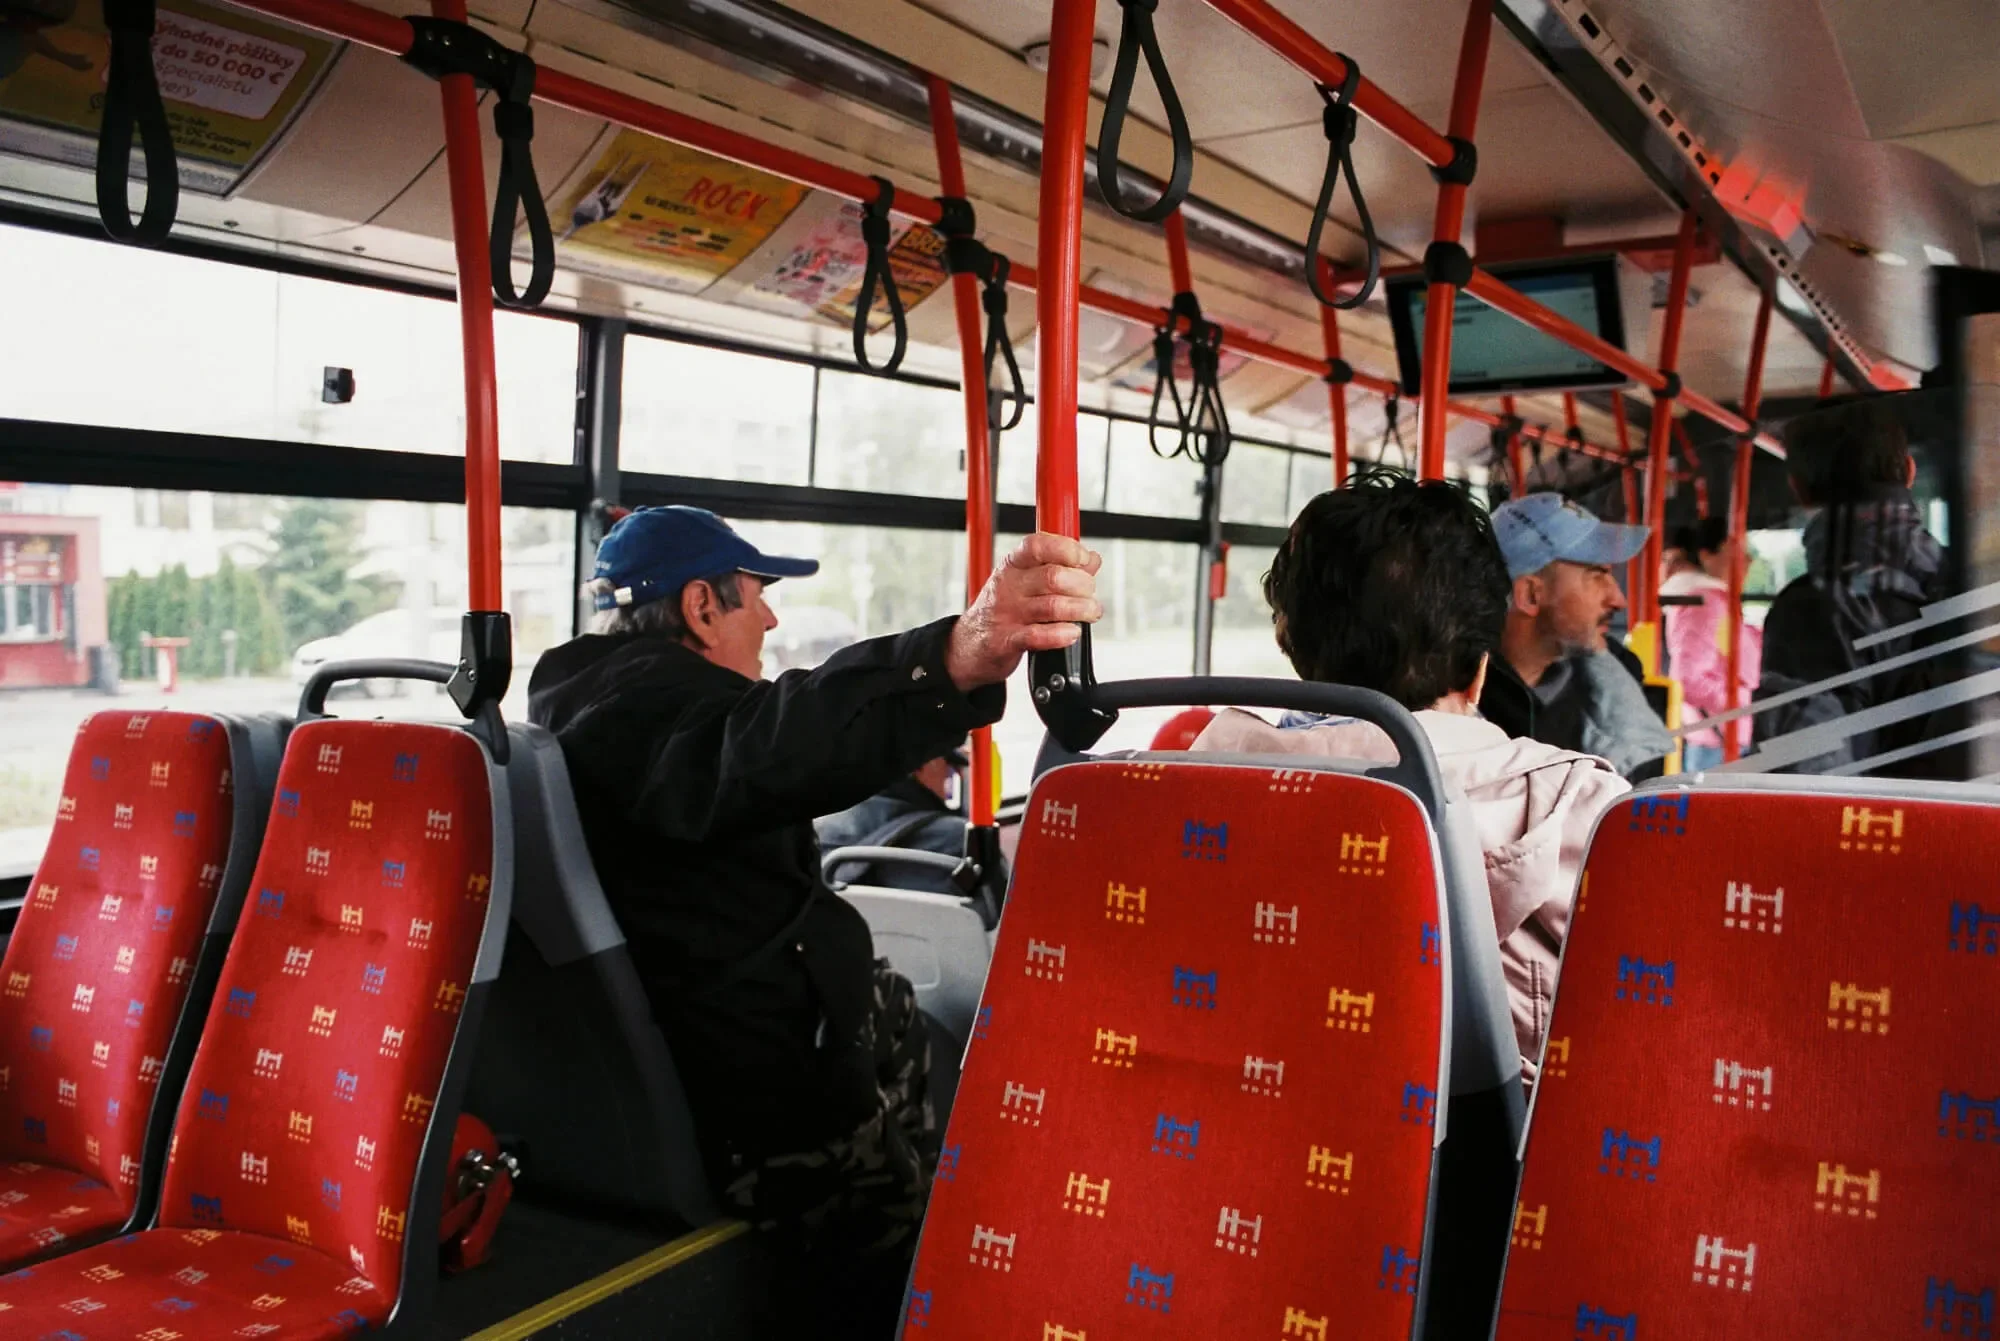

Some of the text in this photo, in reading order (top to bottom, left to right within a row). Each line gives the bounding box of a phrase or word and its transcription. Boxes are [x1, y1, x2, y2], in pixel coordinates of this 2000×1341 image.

[155, 20, 226, 49] ýhodné
[226, 41, 294, 70] pôžičky
[160, 43, 188, 59] do
[190, 49, 220, 67] 50
[222, 59, 266, 80] 000
[682, 175, 769, 221] ROCK
